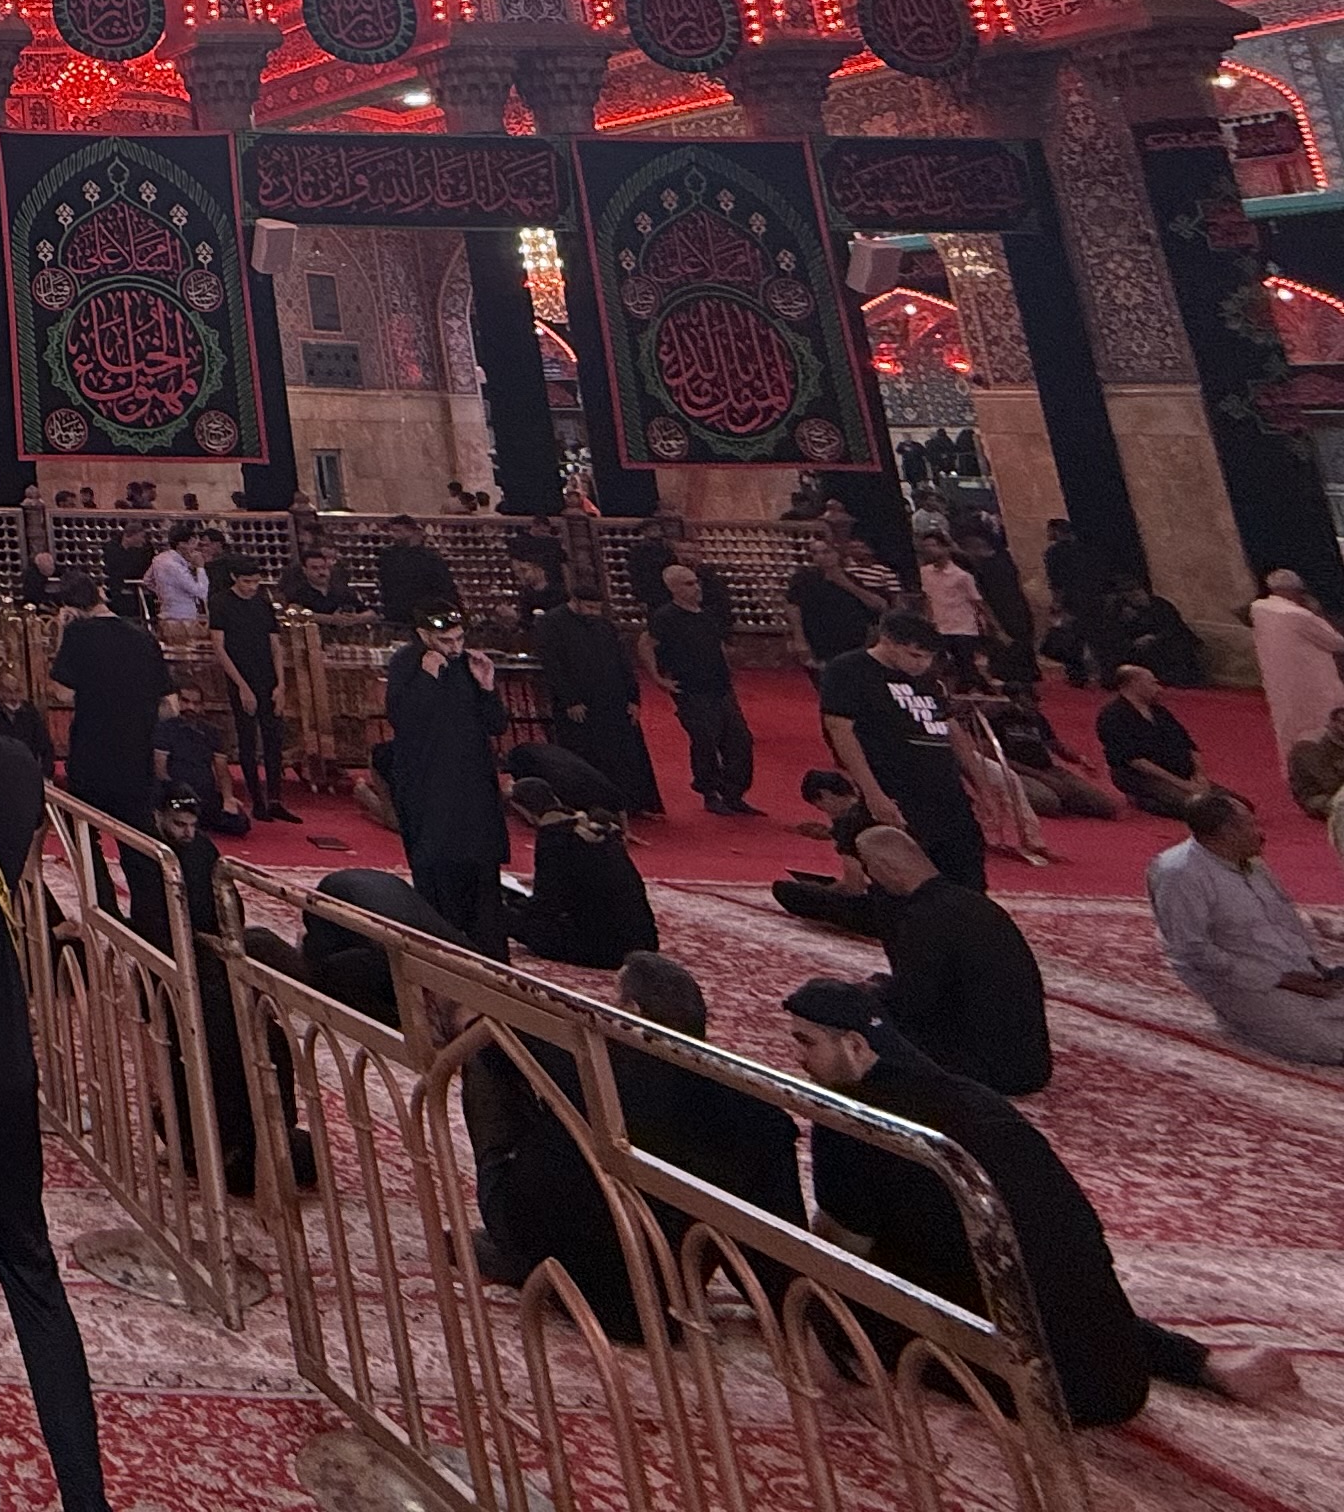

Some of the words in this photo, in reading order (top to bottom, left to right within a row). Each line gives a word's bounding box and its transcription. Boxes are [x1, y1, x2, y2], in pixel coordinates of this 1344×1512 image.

[887, 682, 914, 701] NO
[897, 694, 938, 714] TIME
[912, 707, 933, 723] TO
